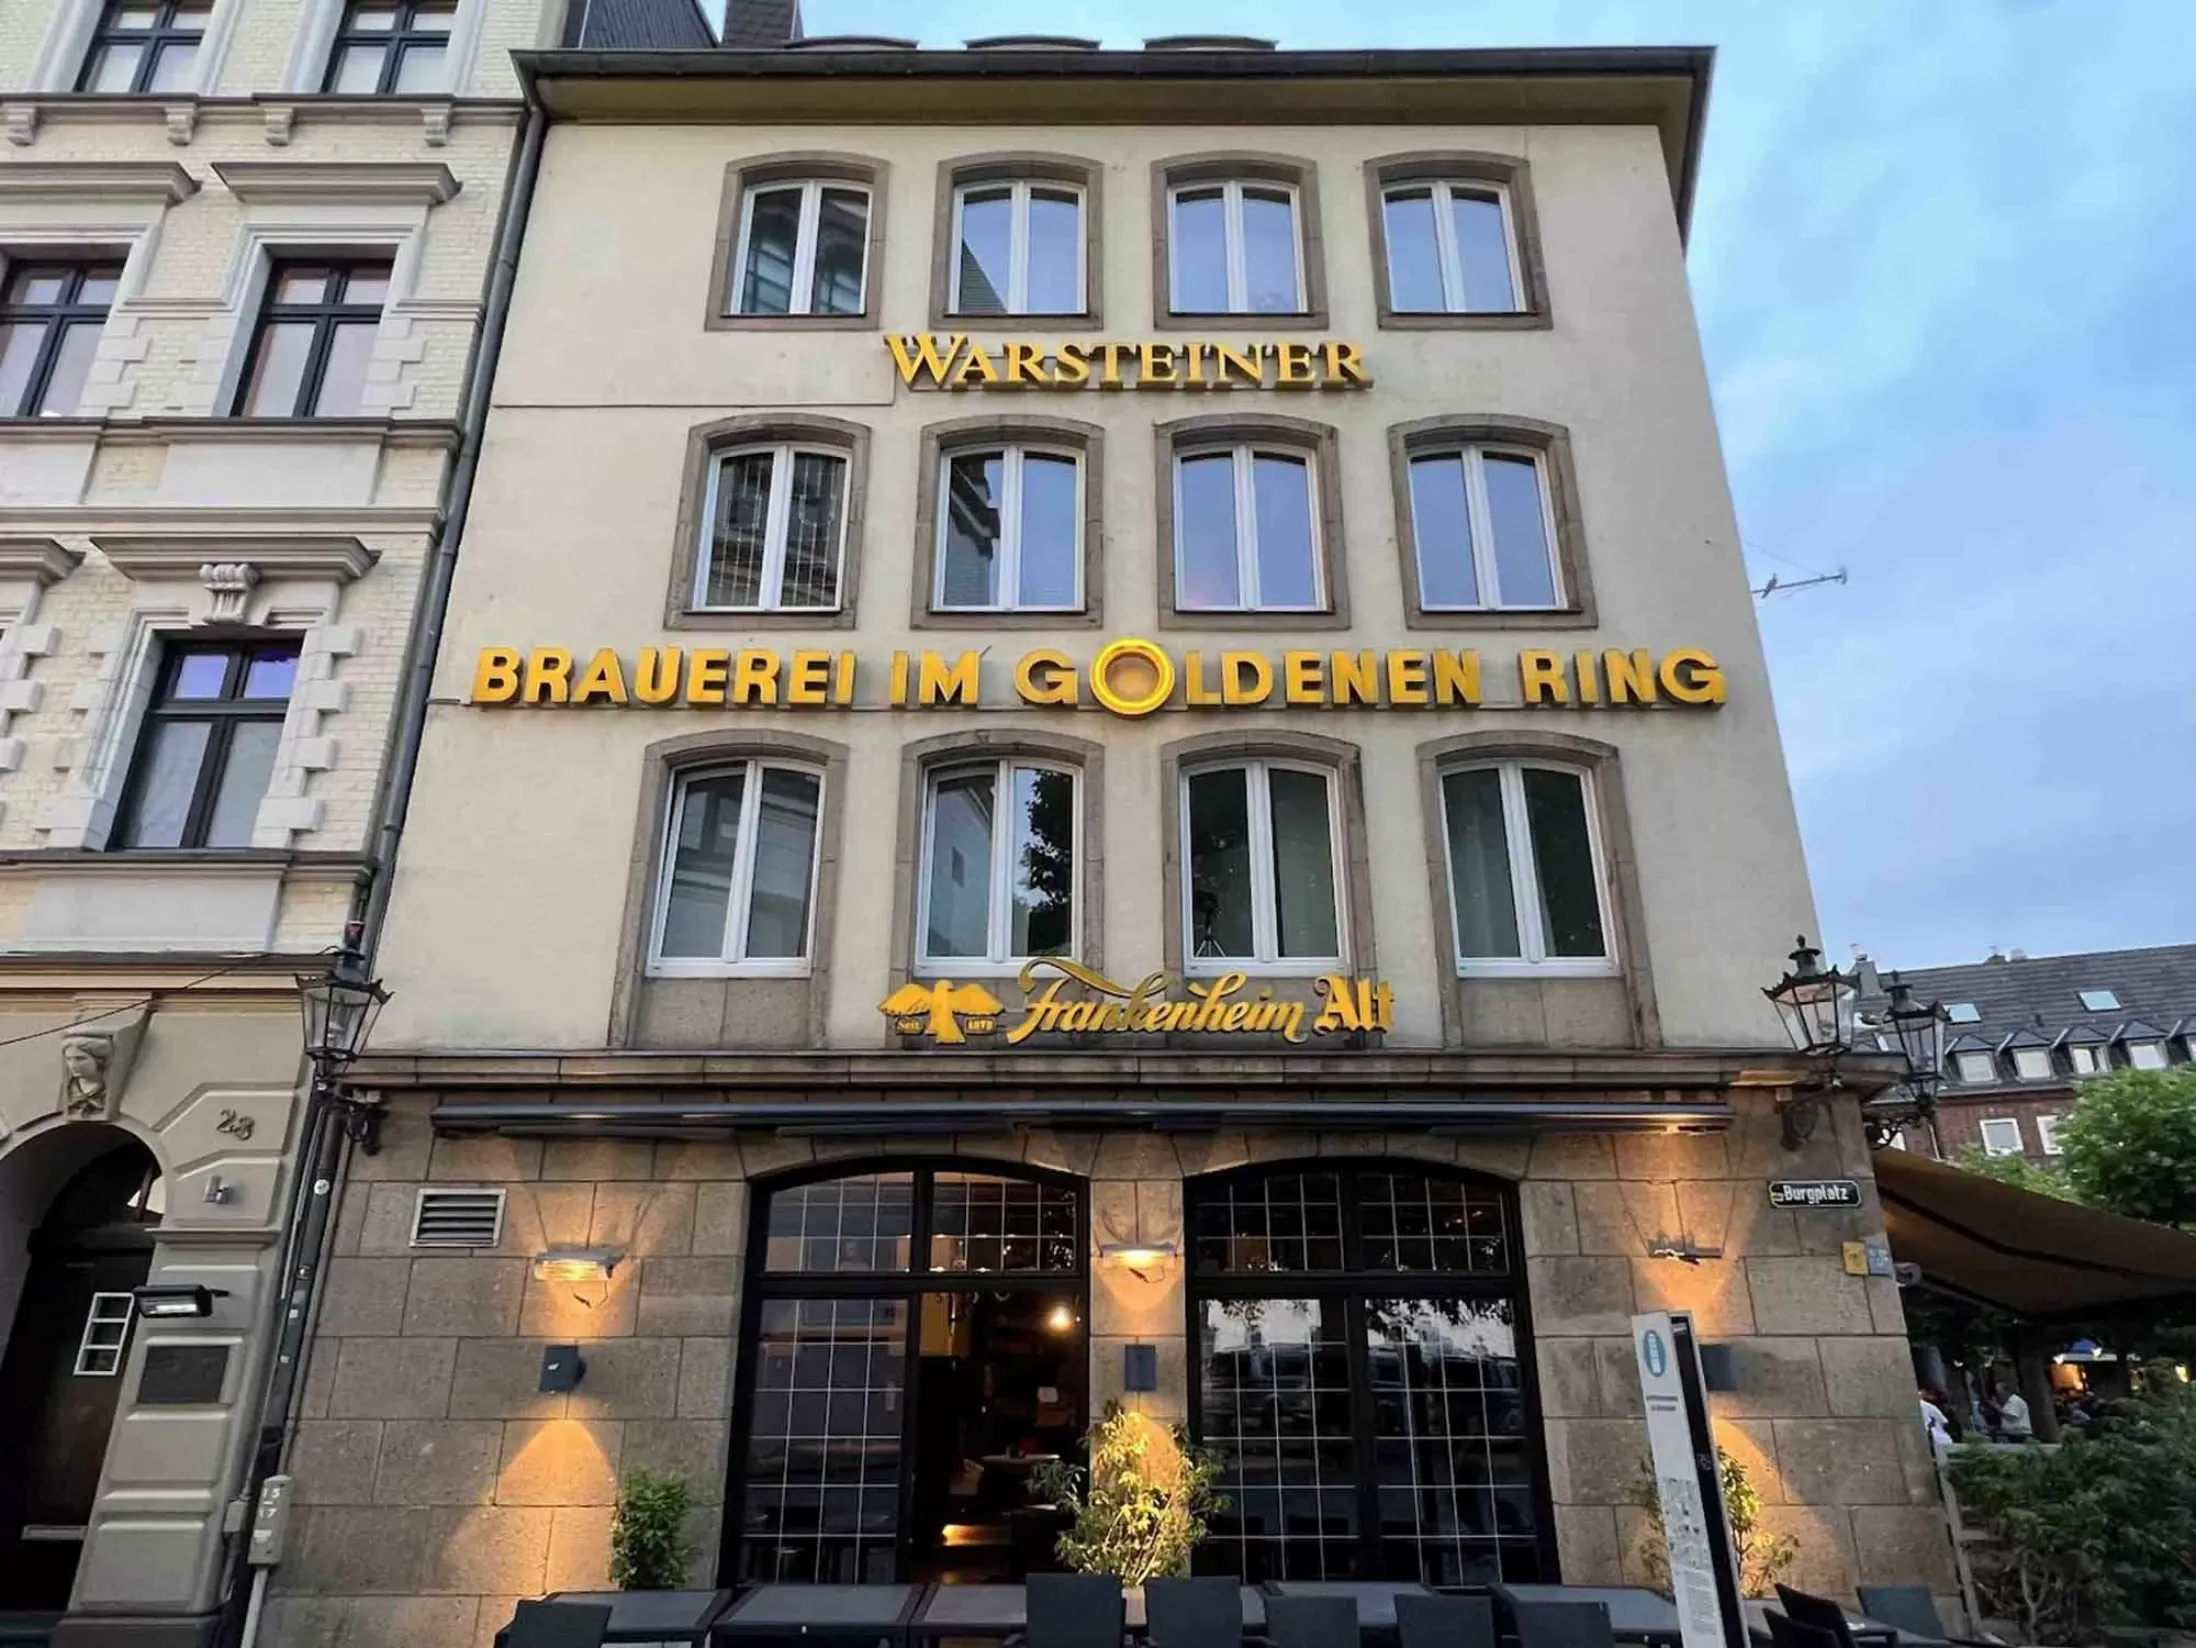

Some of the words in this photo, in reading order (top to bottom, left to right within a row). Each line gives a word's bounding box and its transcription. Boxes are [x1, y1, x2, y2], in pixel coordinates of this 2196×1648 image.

[883, 334, 1375, 391] WARSTEINER
[471, 645, 858, 706] BRAUEREI
[890, 649, 985, 706] IM
[1014, 638, 1484, 717] GOLDENEN
[1519, 648, 1728, 706] RING
[1005, 956, 1310, 1044] Frankenheim
[1312, 974, 1396, 1035] Alt
[1782, 1184, 1849, 1205] Burgplatz
